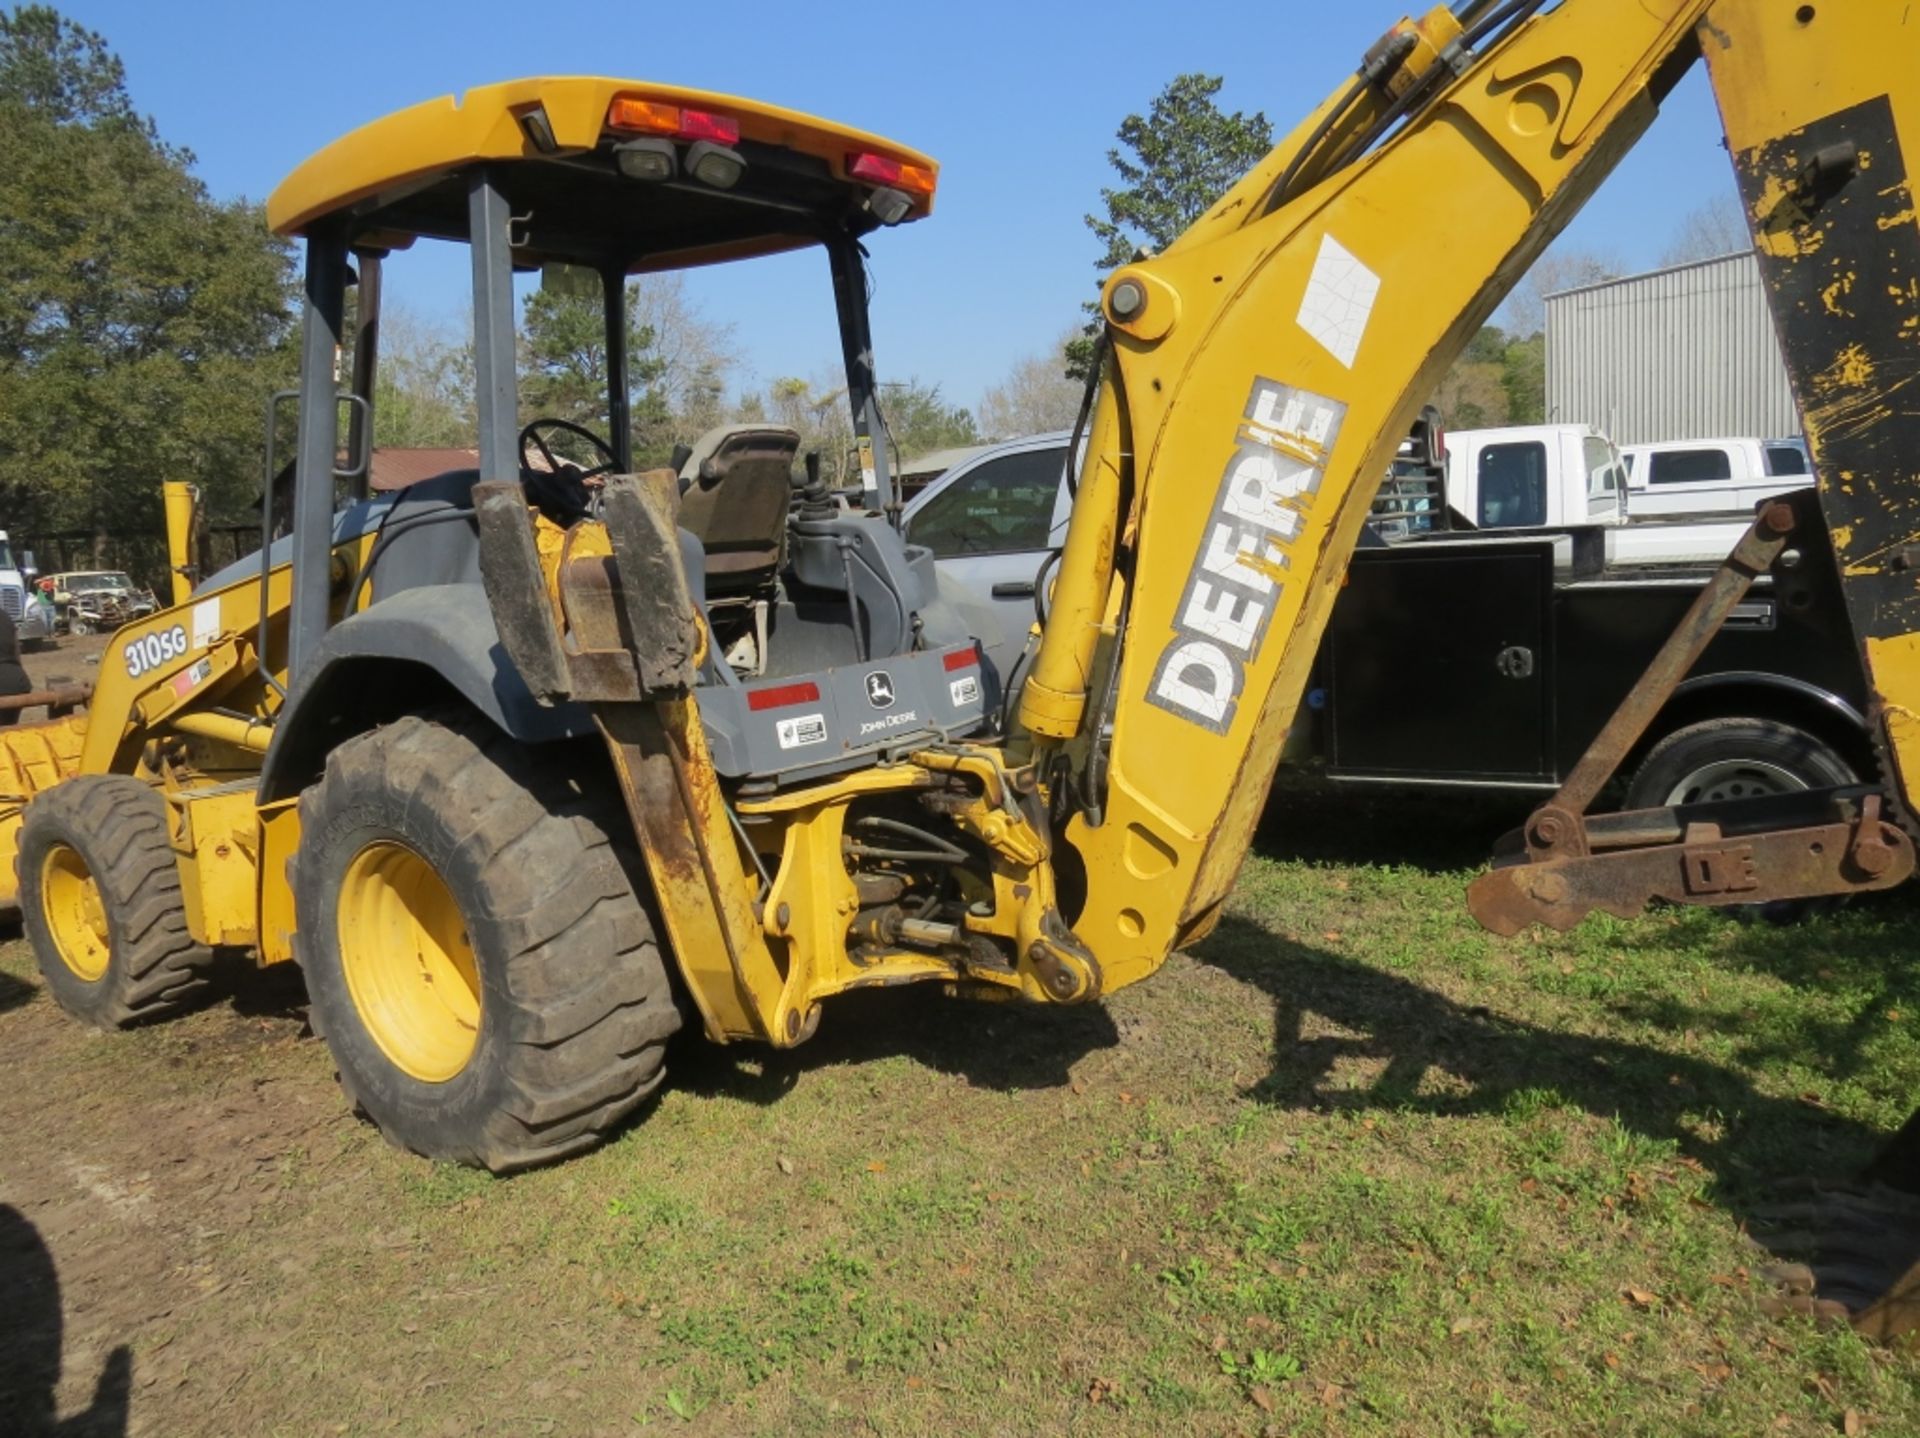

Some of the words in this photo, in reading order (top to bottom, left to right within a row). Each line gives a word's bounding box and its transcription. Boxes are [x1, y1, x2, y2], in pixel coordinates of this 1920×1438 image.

[1151, 383, 1341, 730] DEERE
[125, 625, 187, 678] 310SG
[860, 721, 886, 735] JOHN
[886, 710, 917, 726] DEERE
